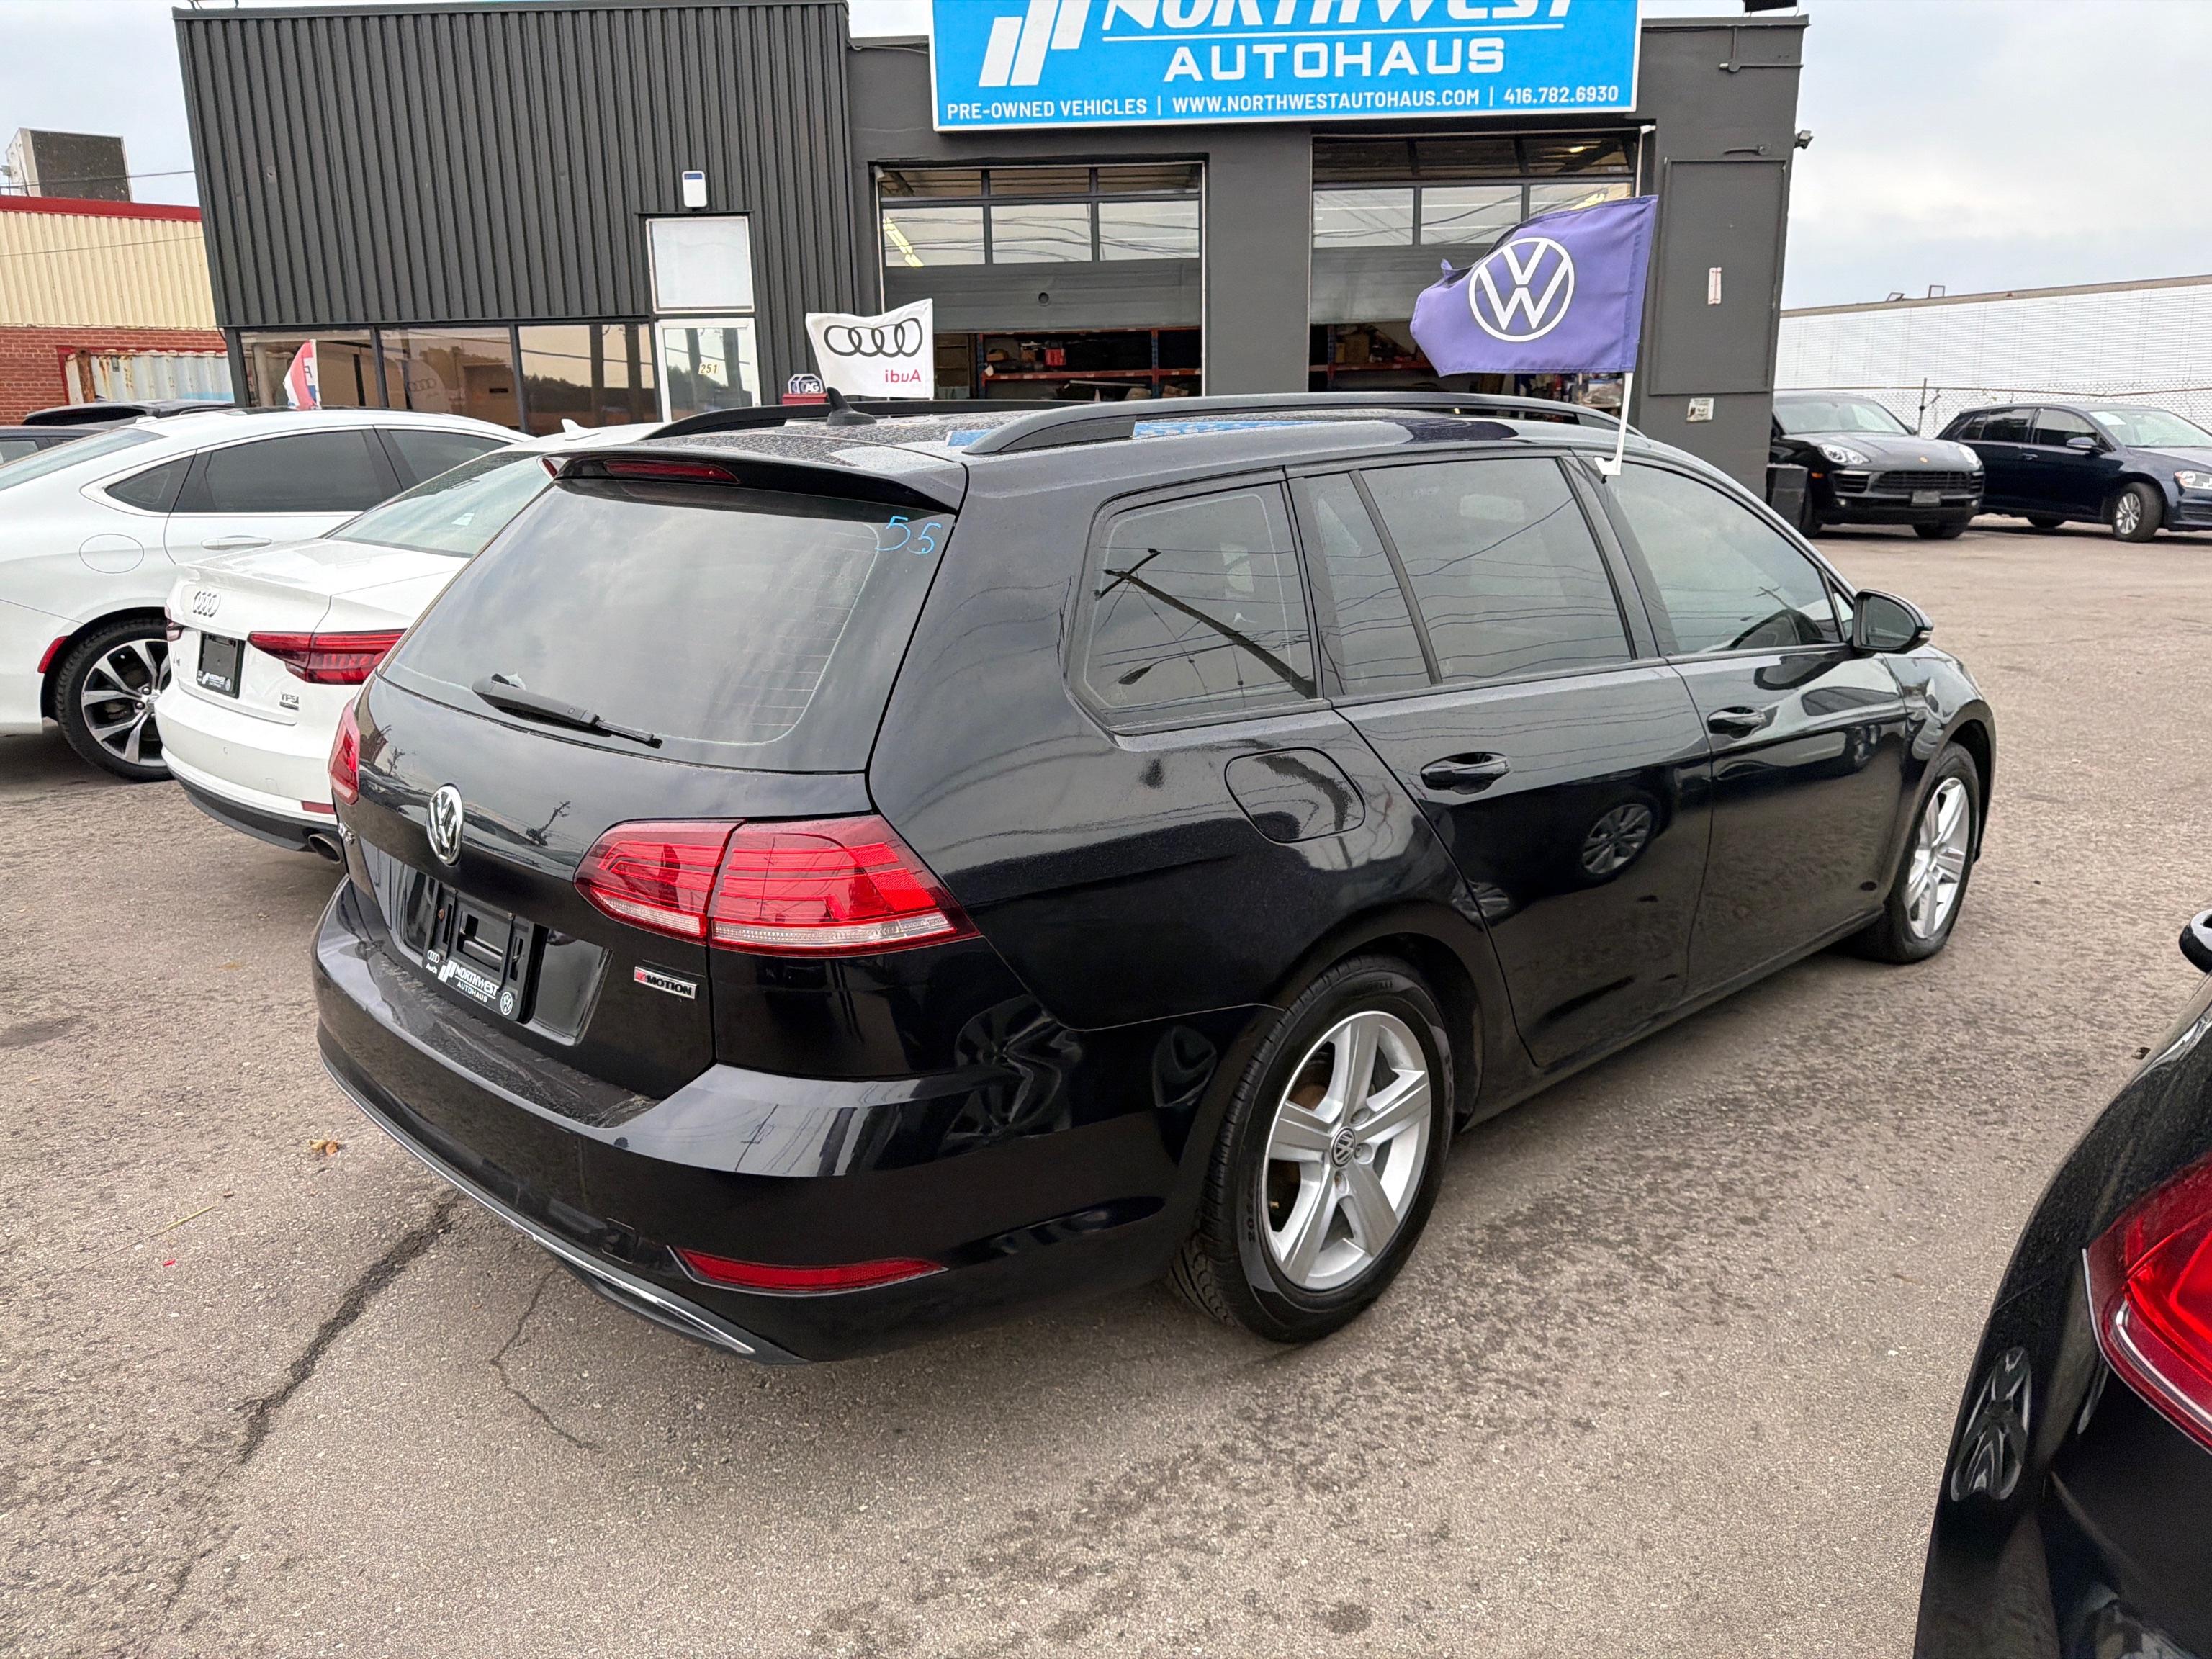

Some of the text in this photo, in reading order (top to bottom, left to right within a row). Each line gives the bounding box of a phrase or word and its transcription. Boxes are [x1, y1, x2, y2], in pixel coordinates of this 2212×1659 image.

[1163, 37, 1505, 82] AUTOHAUS
[947, 85, 1619, 120] PRE-OWNED VEHICLES WWW.NORTHWESTAUTOHAUS.COM 416.782.6930
[700, 364, 719, 374] 251
[874, 516, 942, 555] 55
[454, 964, 499, 996] NORTHWEST
[457, 981, 488, 1003] AUTOHAUS
